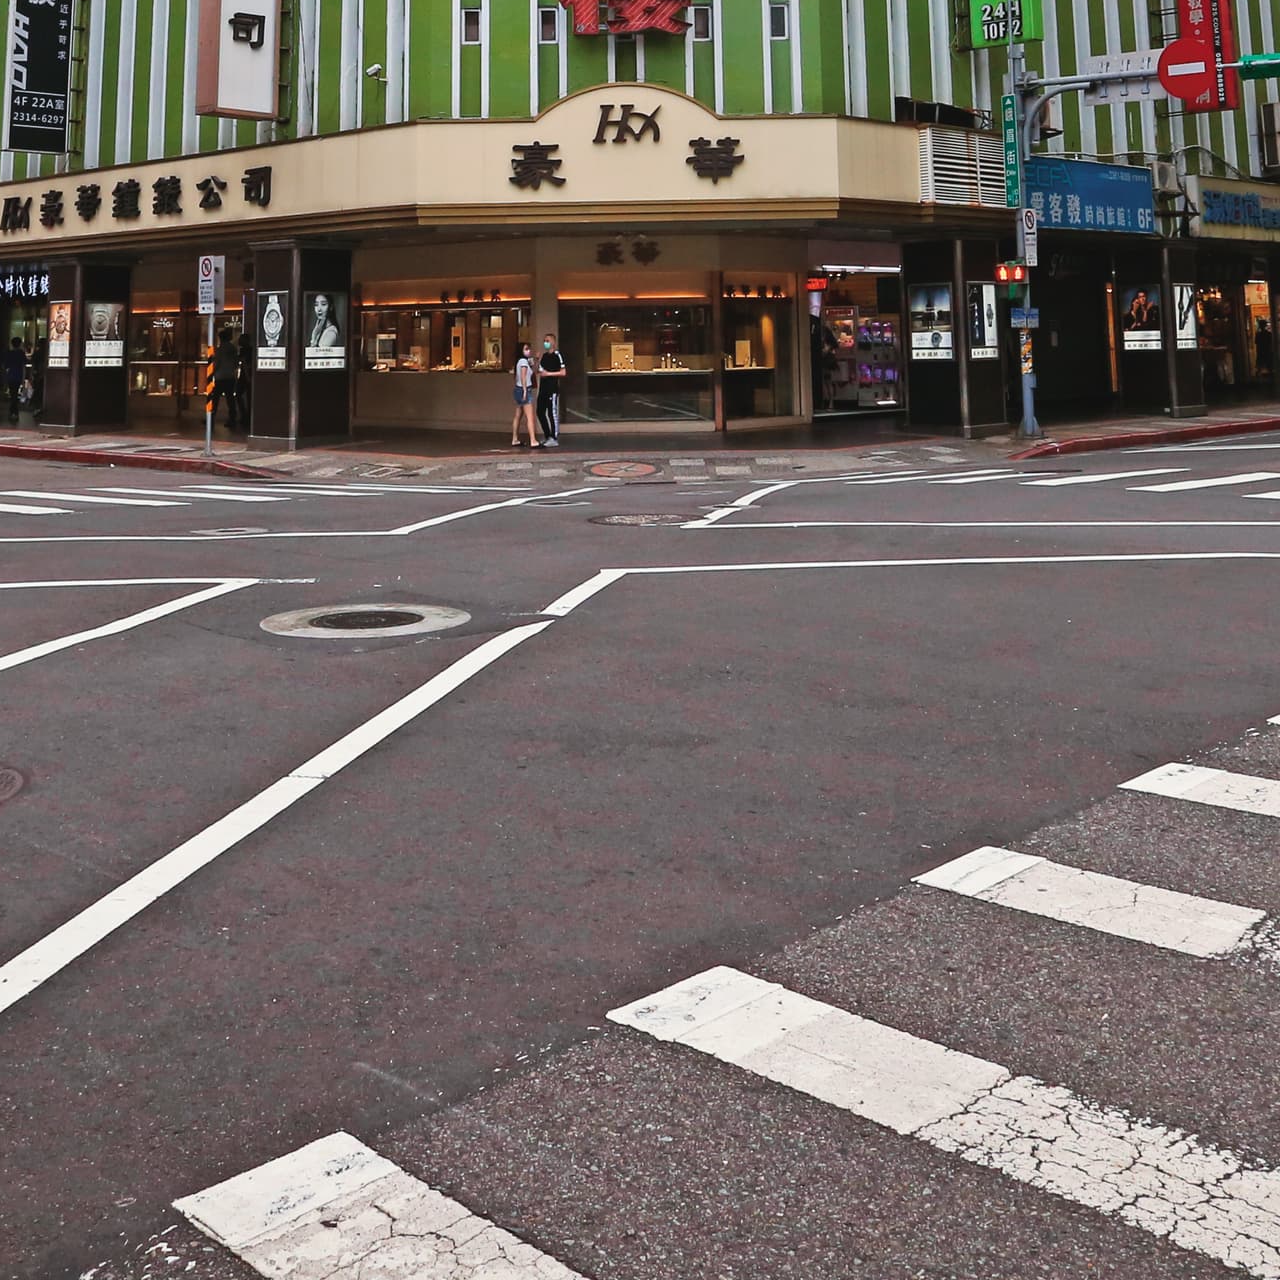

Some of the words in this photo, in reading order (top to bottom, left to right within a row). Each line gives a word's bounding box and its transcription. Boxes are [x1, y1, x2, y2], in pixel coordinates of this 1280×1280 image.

[14, 96, 29, 107] 4F
[32, 97, 65, 111] 22A室
[14, 111, 65, 125] 2314-6297
[39, 166, 272, 228] 豪華鐘錶公司
[1137, 207, 1153, 230] 6F
